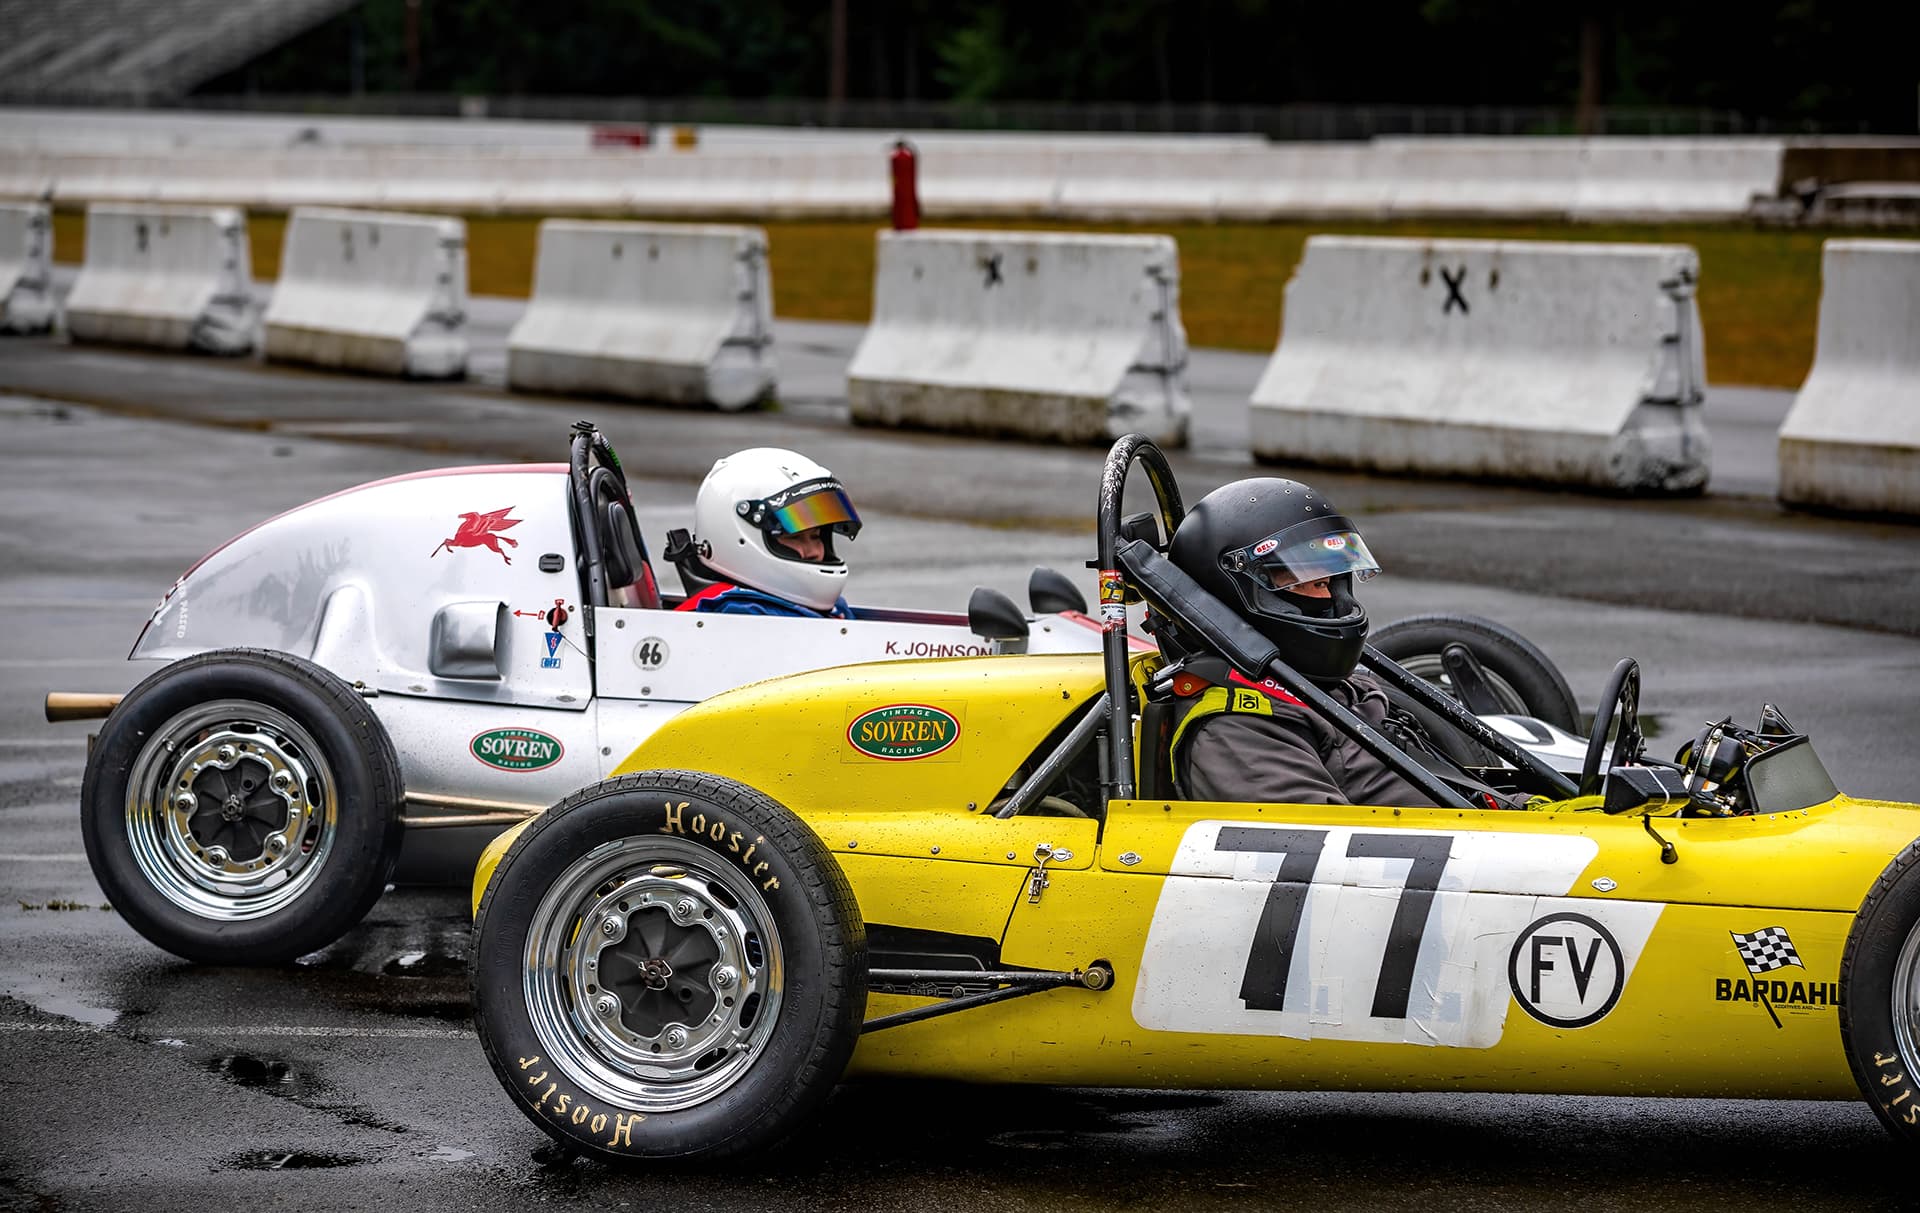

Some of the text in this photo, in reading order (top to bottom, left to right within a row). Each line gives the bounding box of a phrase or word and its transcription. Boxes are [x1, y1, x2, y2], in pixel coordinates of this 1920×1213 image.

[1256, 541, 1276, 553] BELL
[1327, 539, 1345, 547] BELL
[639, 642, 662, 665] 46
[885, 640, 993, 657] K. JOHNSON
[882, 708, 931, 718] VINTAGE
[500, 731, 540, 740] VINTAGE
[861, 719, 948, 742] SOVREN
[480, 737, 555, 760] SOVREN
[882, 746, 923, 755] RACING
[498, 759, 532, 768] RACING
[659, 801, 780, 891] Hoosier
[1215, 826, 1454, 1019] 77
[1531, 936, 1602, 1005] FV
[1716, 978, 1840, 1006] BARDAHL
[519, 1056, 647, 1147] Hoosier
